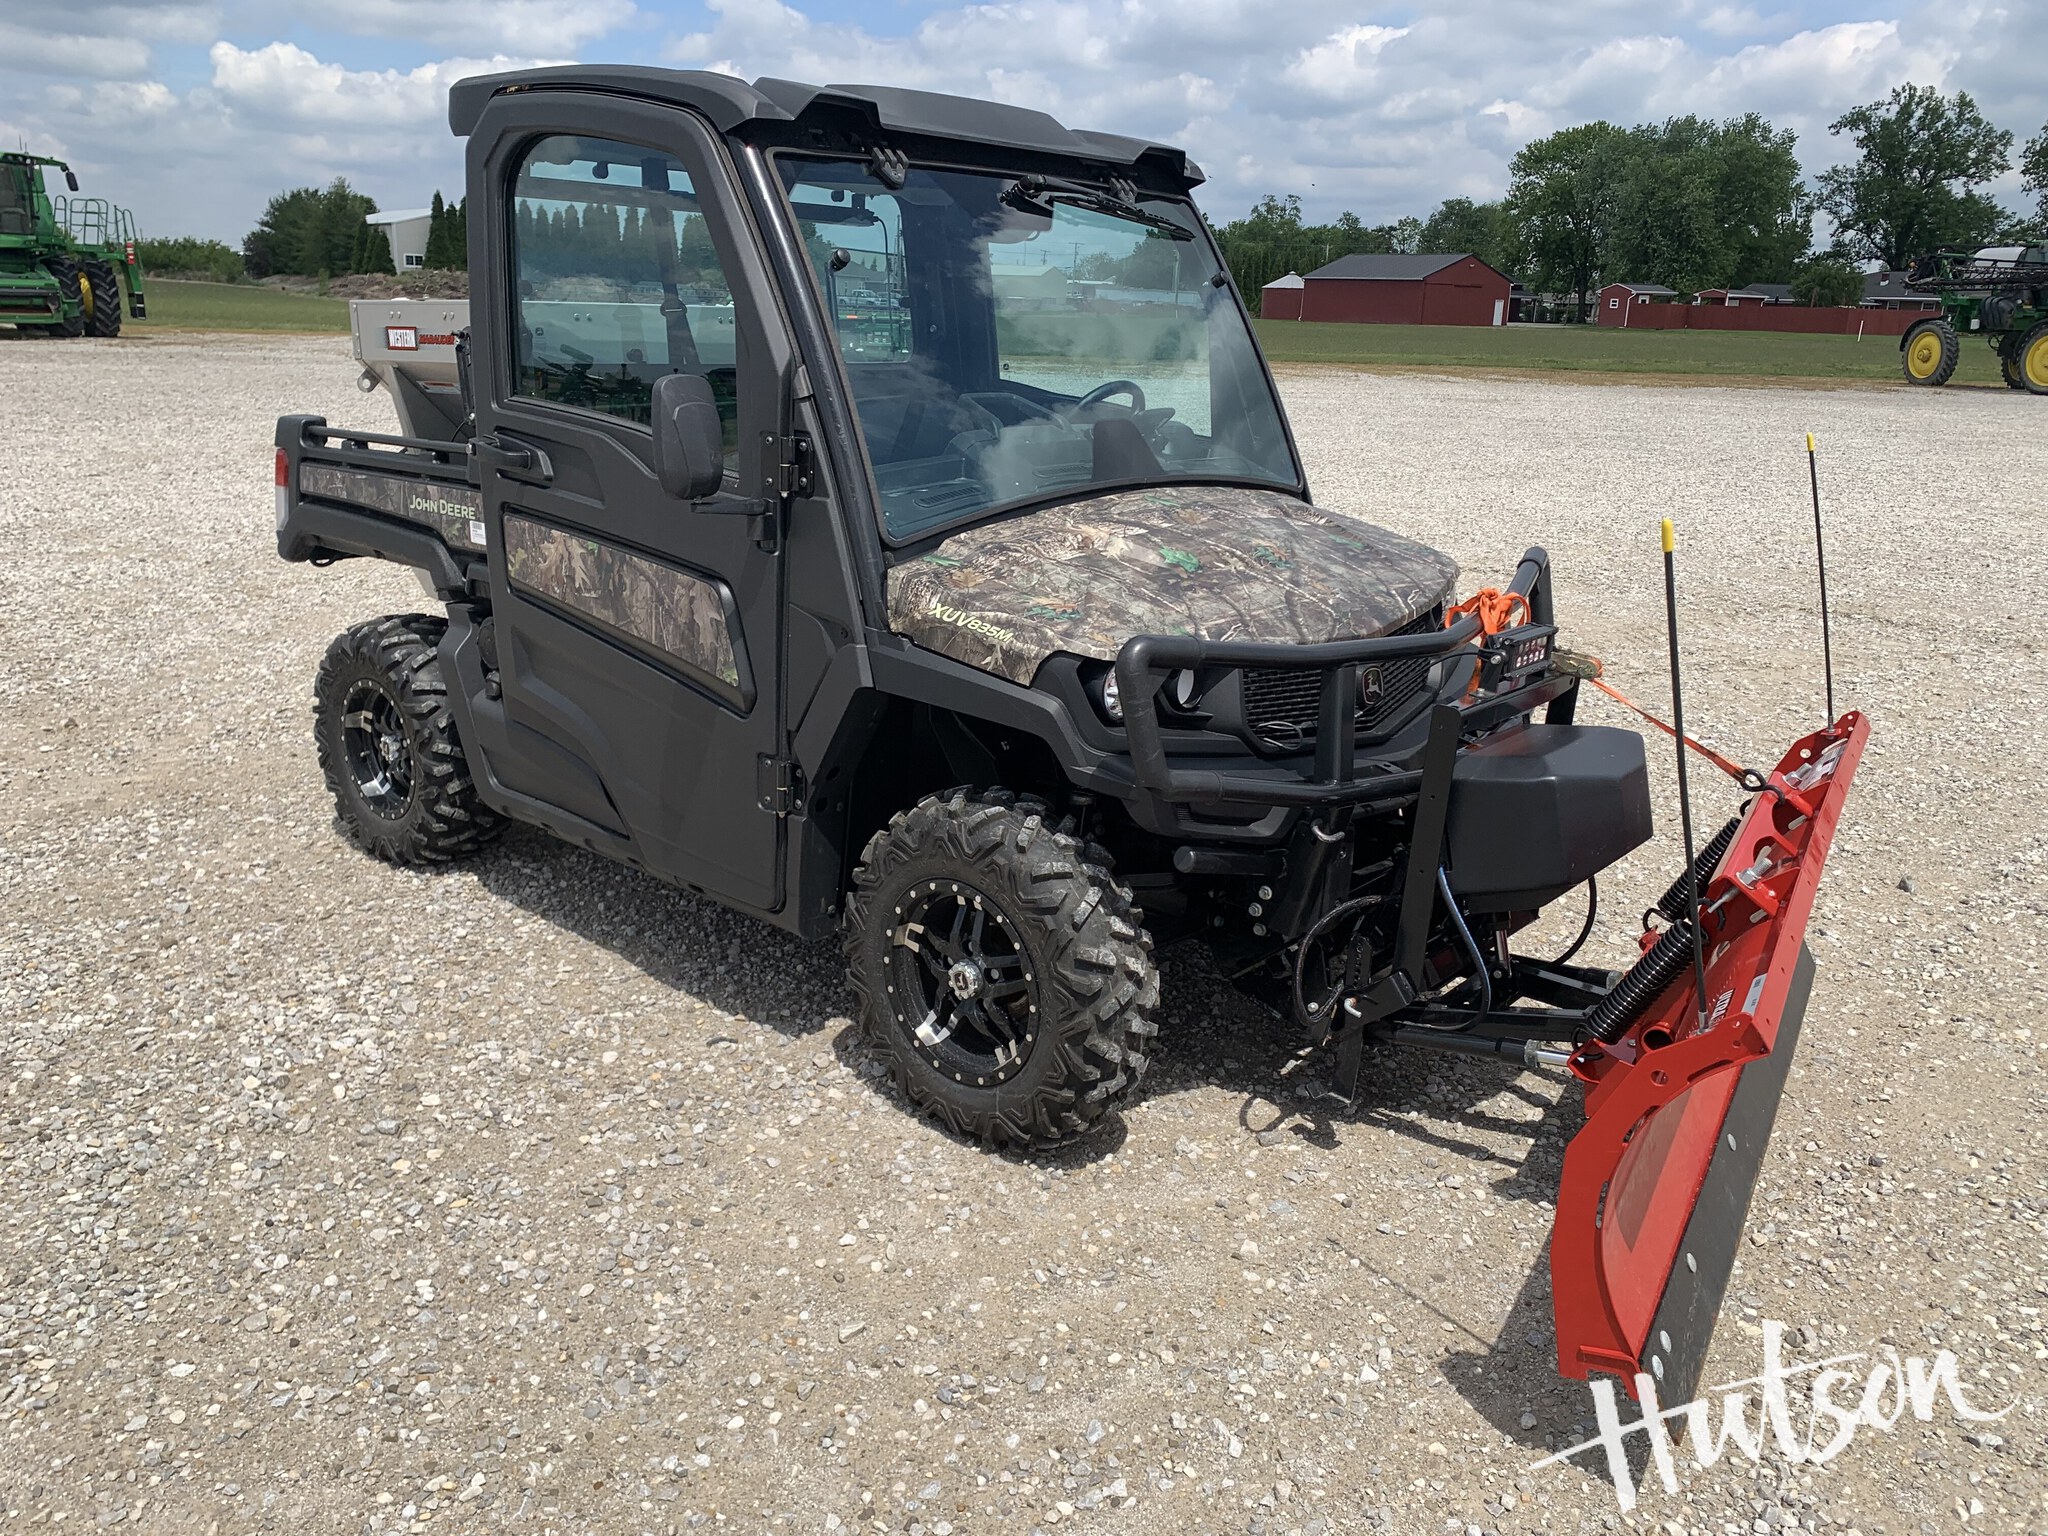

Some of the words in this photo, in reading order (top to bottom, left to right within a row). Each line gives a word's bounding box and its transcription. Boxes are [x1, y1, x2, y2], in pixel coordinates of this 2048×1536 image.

[409, 494, 438, 513] JOHN
[439, 502, 476, 520] DEERE
[927, 602, 1014, 642] XUV835M
